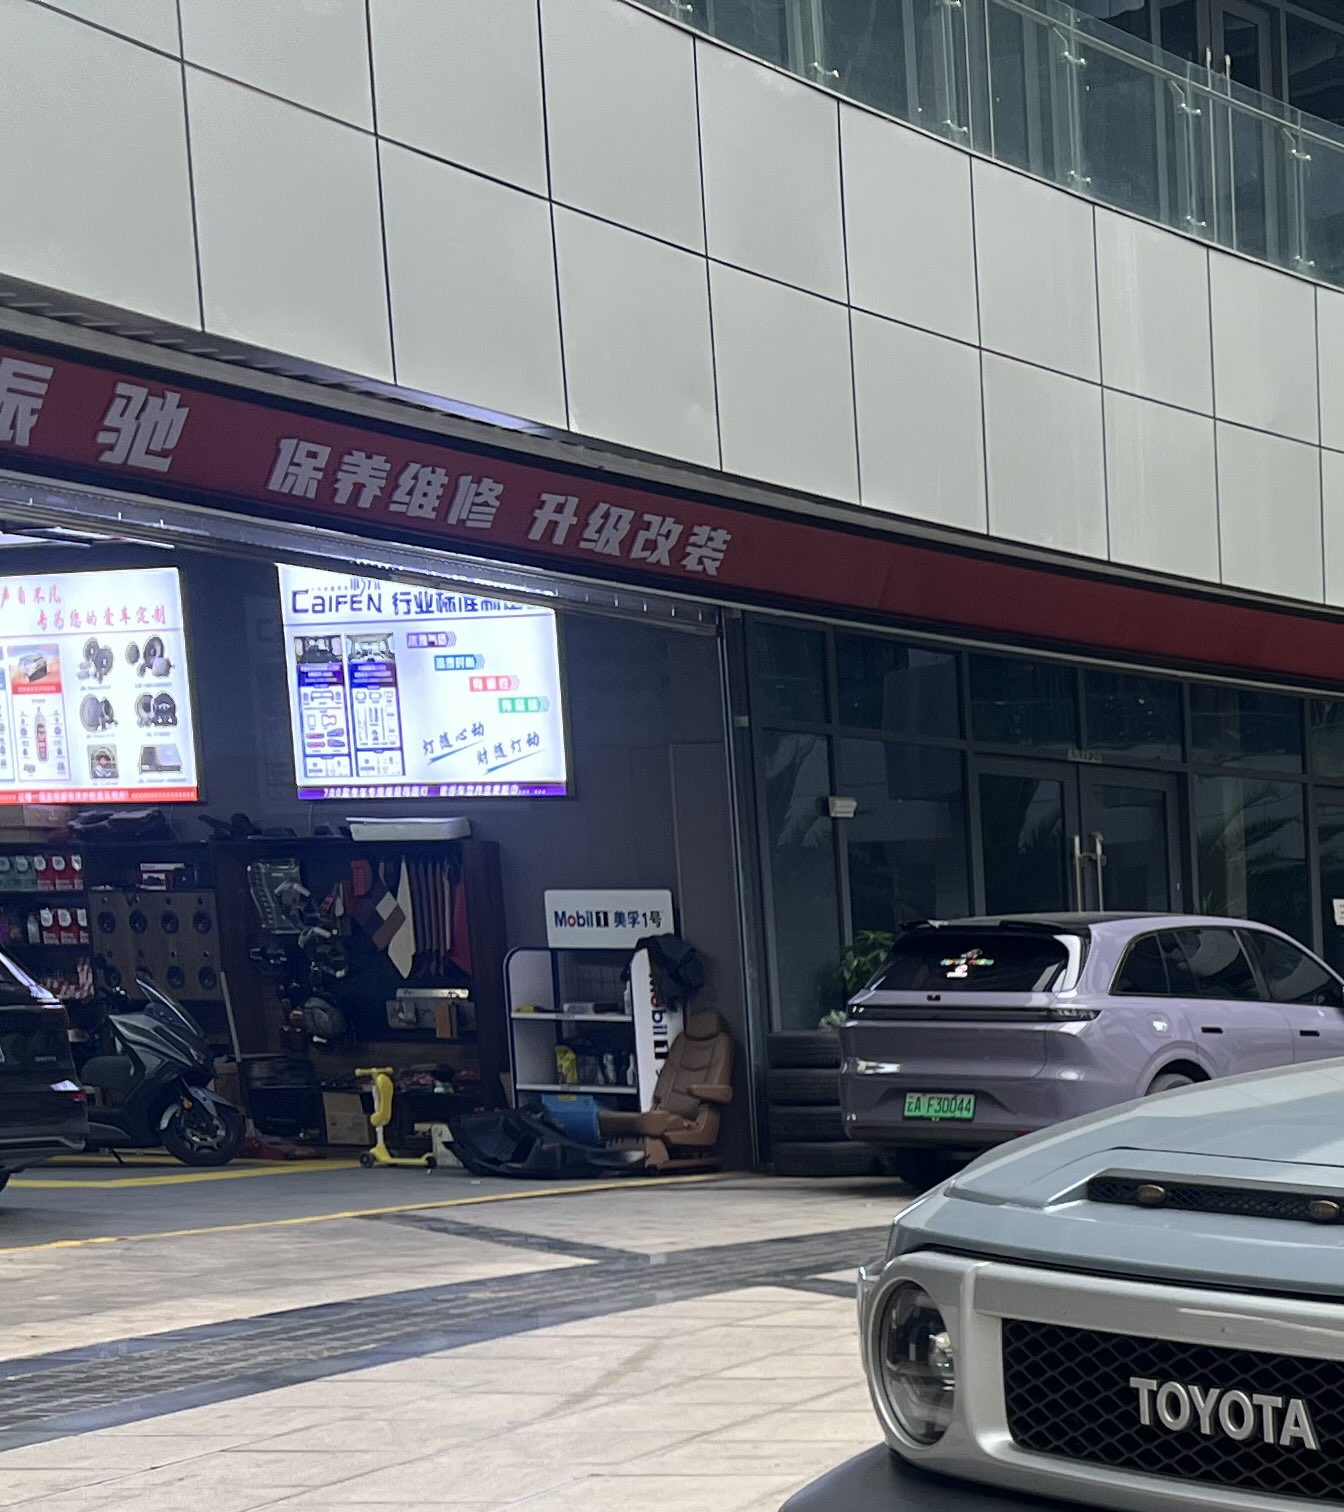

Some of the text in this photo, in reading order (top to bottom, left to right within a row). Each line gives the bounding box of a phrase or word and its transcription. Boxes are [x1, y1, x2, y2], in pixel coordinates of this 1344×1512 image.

[267, 438, 504, 530] 保养维修
[528, 492, 732, 576] 升级改装
[554, 910, 594, 928] Mobil
[613, 911, 663, 929] 美孚1号
[1129, 1376, 1321, 1450] TOYOTA
